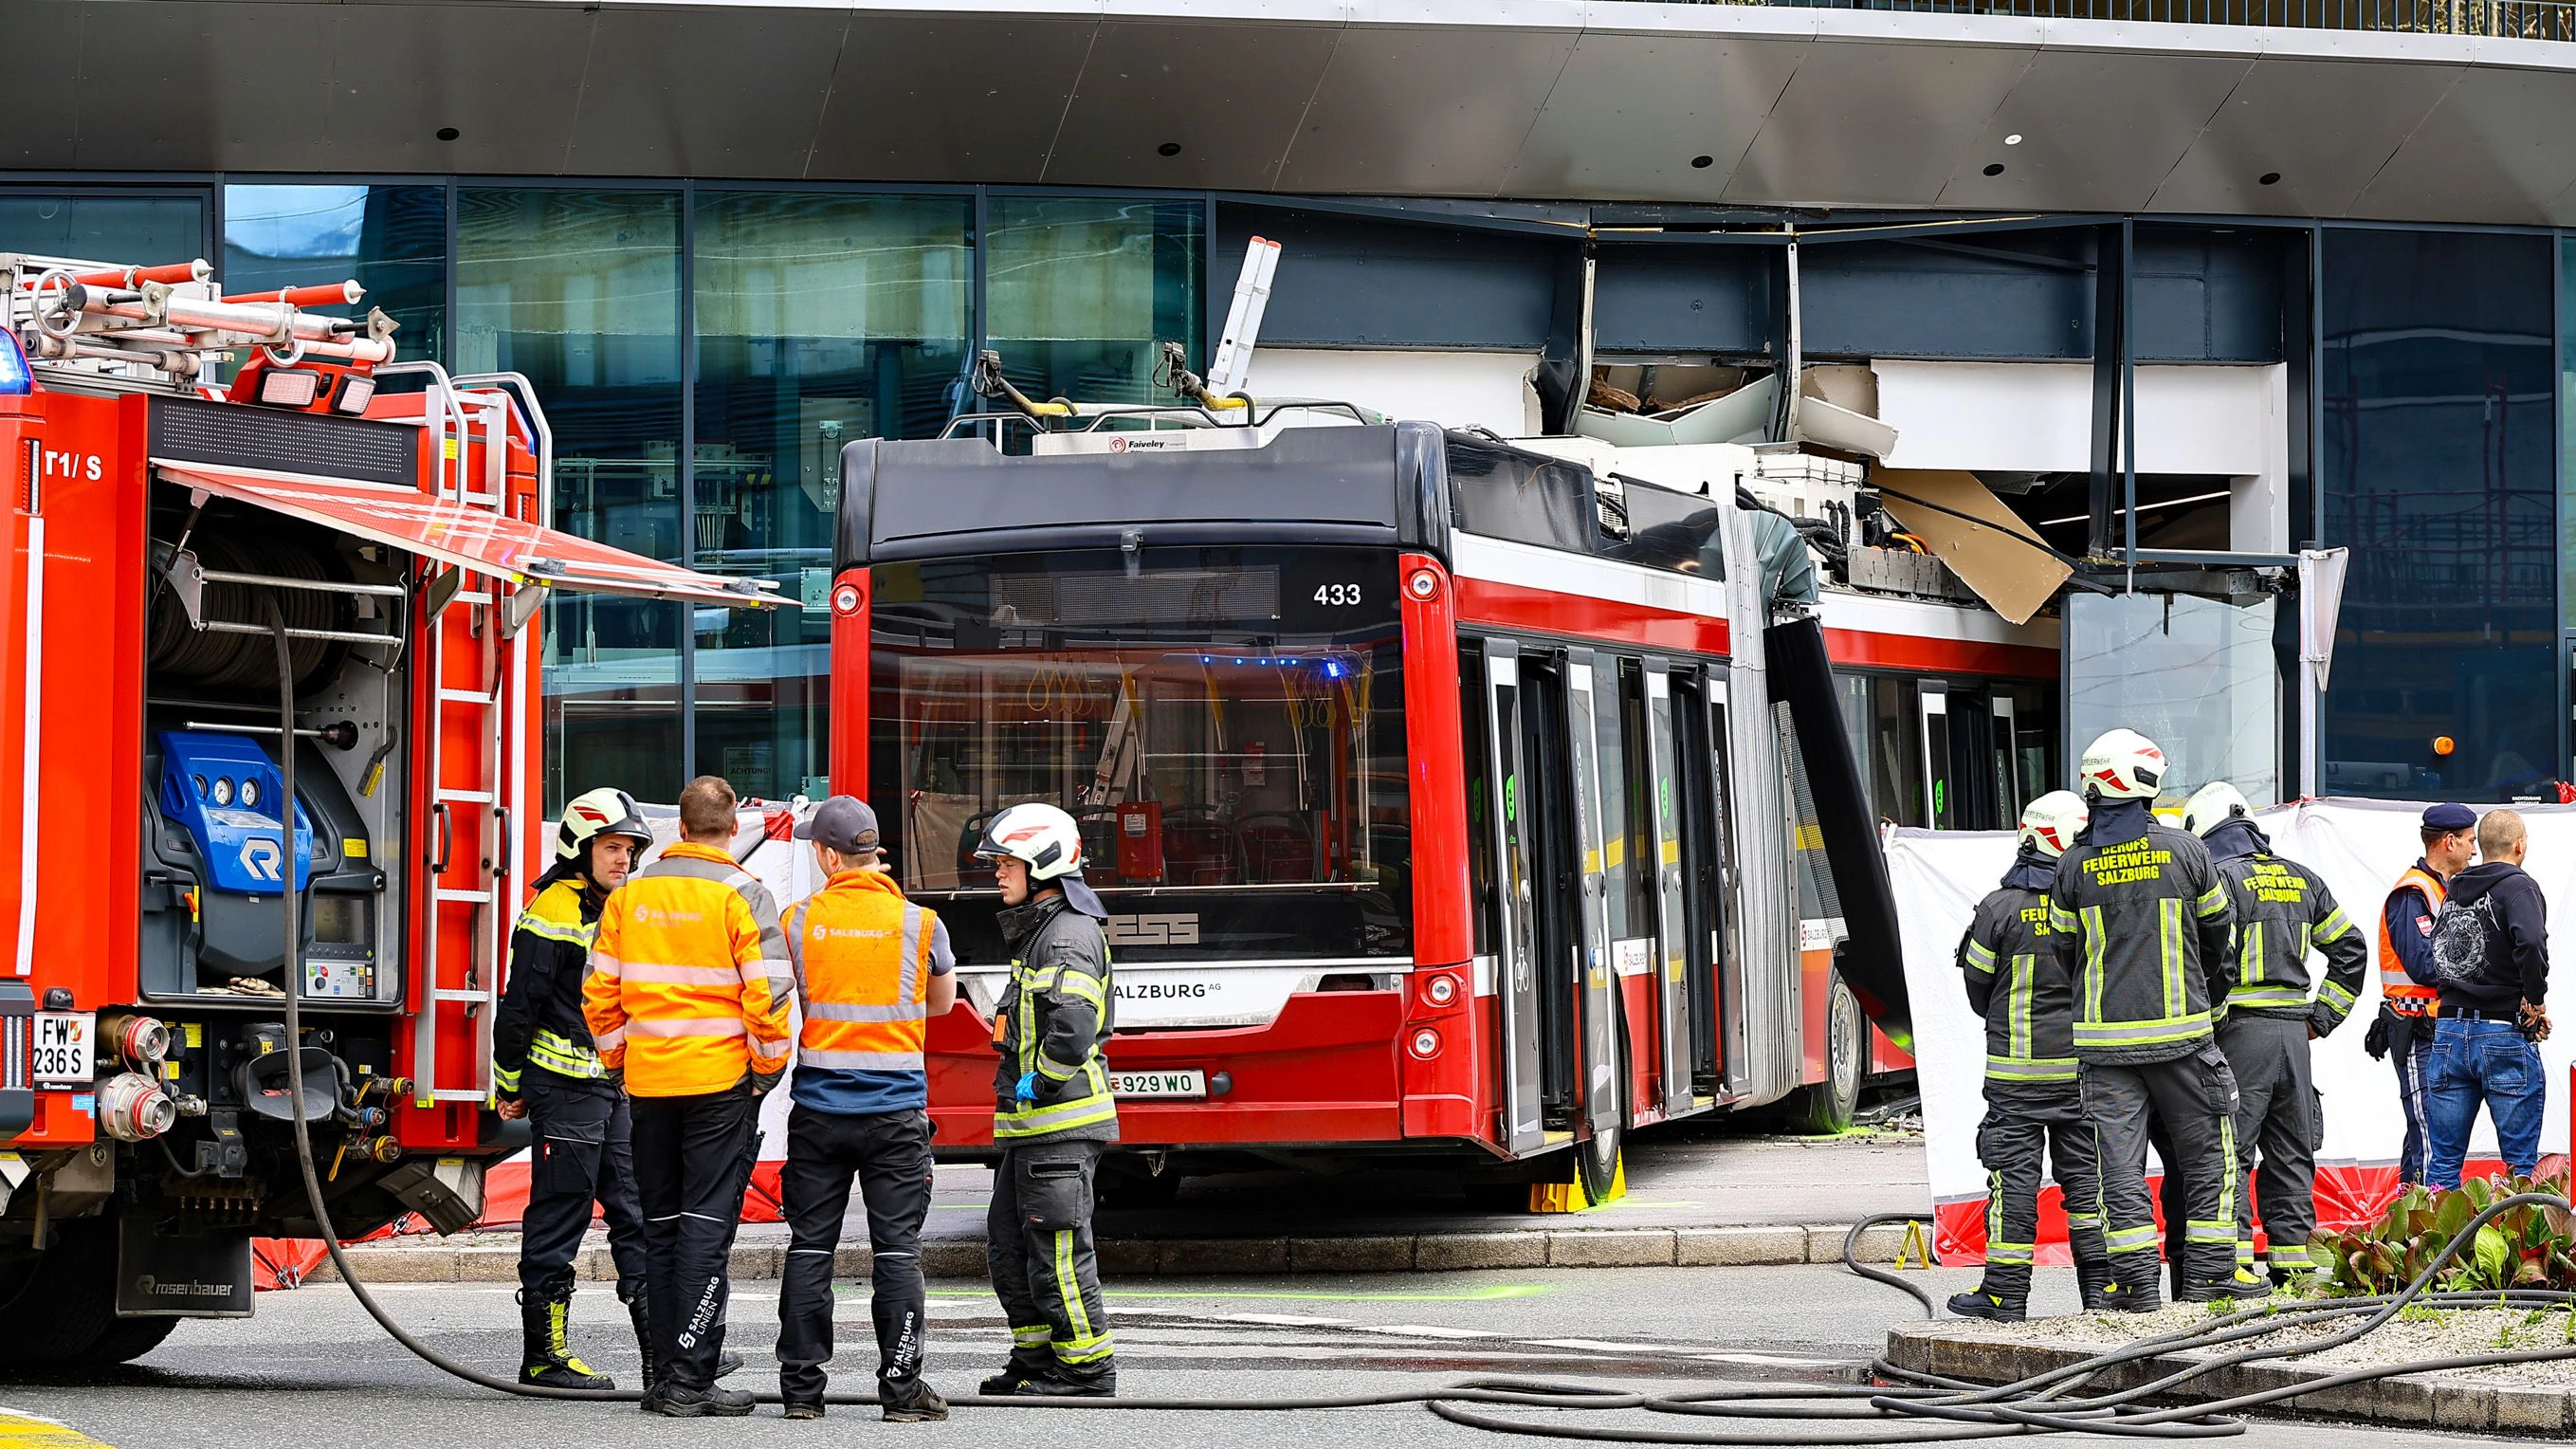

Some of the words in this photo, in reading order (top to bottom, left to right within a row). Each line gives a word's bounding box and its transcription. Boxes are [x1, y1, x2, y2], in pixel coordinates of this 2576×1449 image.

[1128, 440, 1164, 449] Faiveley
[86, 455, 102, 481] S
[1314, 584, 1361, 605] 433
[730, 767, 771, 776] ACHTUNG!
[2083, 850, 2172, 873] FEUERWEHR
[2097, 865, 2160, 886] SALZBURG
[2242, 874, 2308, 891] FEUERWEHR
[2257, 888, 2302, 903] SALZBURG
[830, 928, 884, 938] SALZBURG
[44, 1018, 68, 1045] FW
[34, 1048, 66, 1074] 236
[71, 1049, 82, 1074] S
[1123, 1075, 1160, 1092] 929
[1164, 1074, 1192, 1091] WO
[155, 1279, 233, 1296] rosenbauer
[688, 1275, 720, 1332] SALZBURG
[696, 1300, 719, 1335] LINIEN
[893, 1311, 915, 1366] SALZBURG
[903, 1335, 918, 1370] LINIEN
